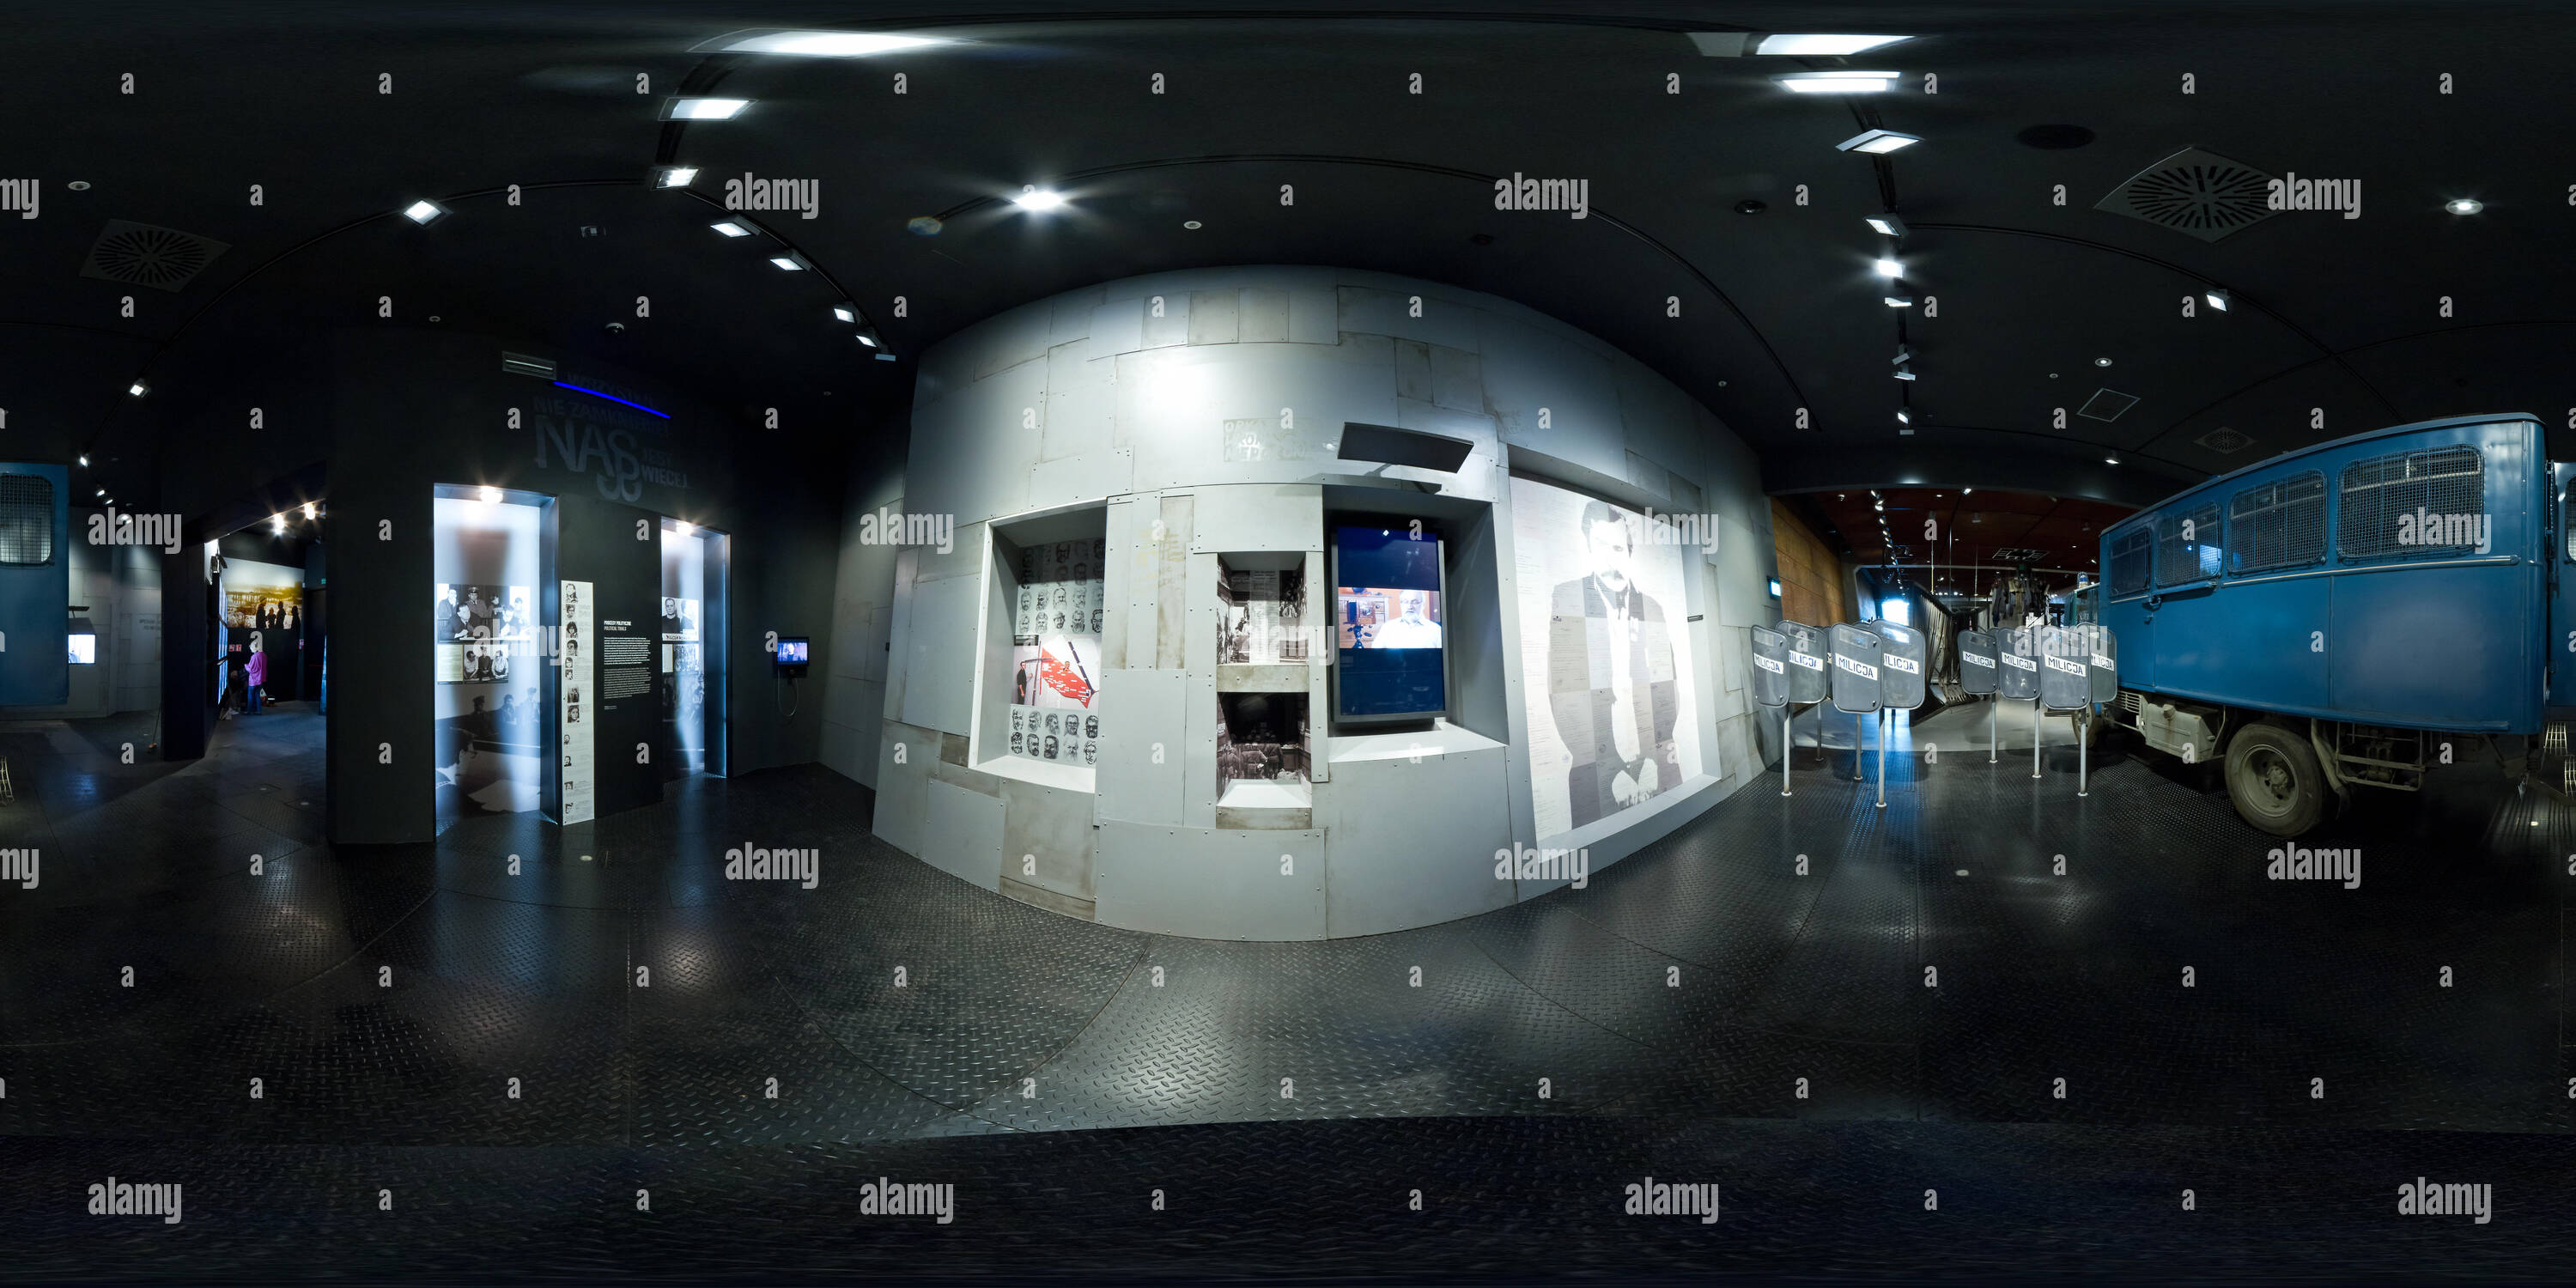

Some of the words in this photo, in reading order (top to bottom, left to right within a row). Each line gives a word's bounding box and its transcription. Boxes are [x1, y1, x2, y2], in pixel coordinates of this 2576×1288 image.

[1838, 657, 1874, 678] MILICJA
[1965, 653, 1994, 667] MILICJA
[2004, 654, 2034, 671] MILICJA
[2048, 657, 2084, 675] MILICJA
